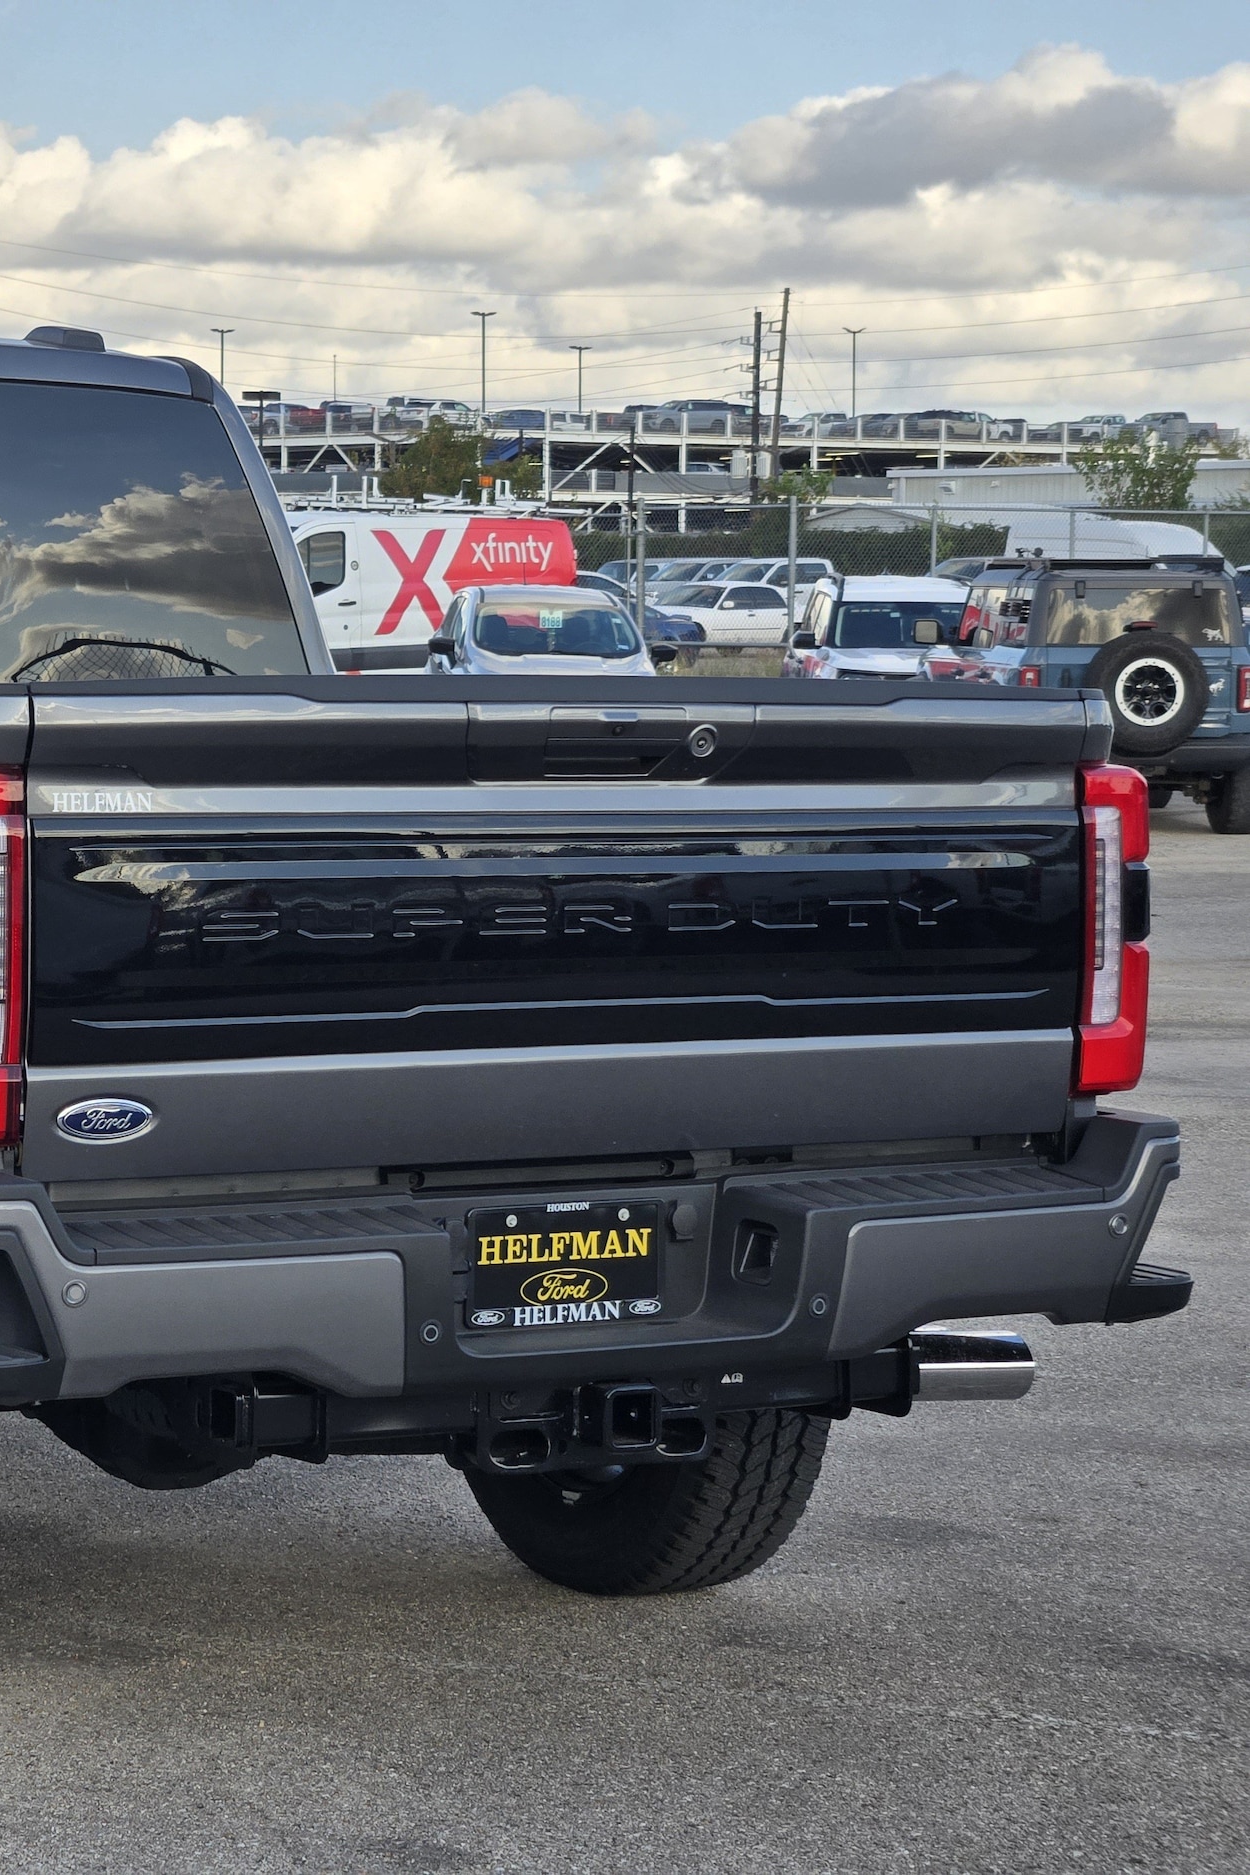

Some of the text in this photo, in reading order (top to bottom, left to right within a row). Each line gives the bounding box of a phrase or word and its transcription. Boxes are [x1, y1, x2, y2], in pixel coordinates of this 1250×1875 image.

[470, 532, 553, 572] xfinity
[52, 792, 152, 813] HELFMAN
[202, 898, 958, 942] SUPER DUTY
[81, 1107, 133, 1131] Ford
[546, 1202, 589, 1213] HOUSTON
[477, 1228, 651, 1265] HELFMAN
[536, 1272, 591, 1302] Ford
[477, 1300, 656, 1327] Ford HELFMAN Ford
